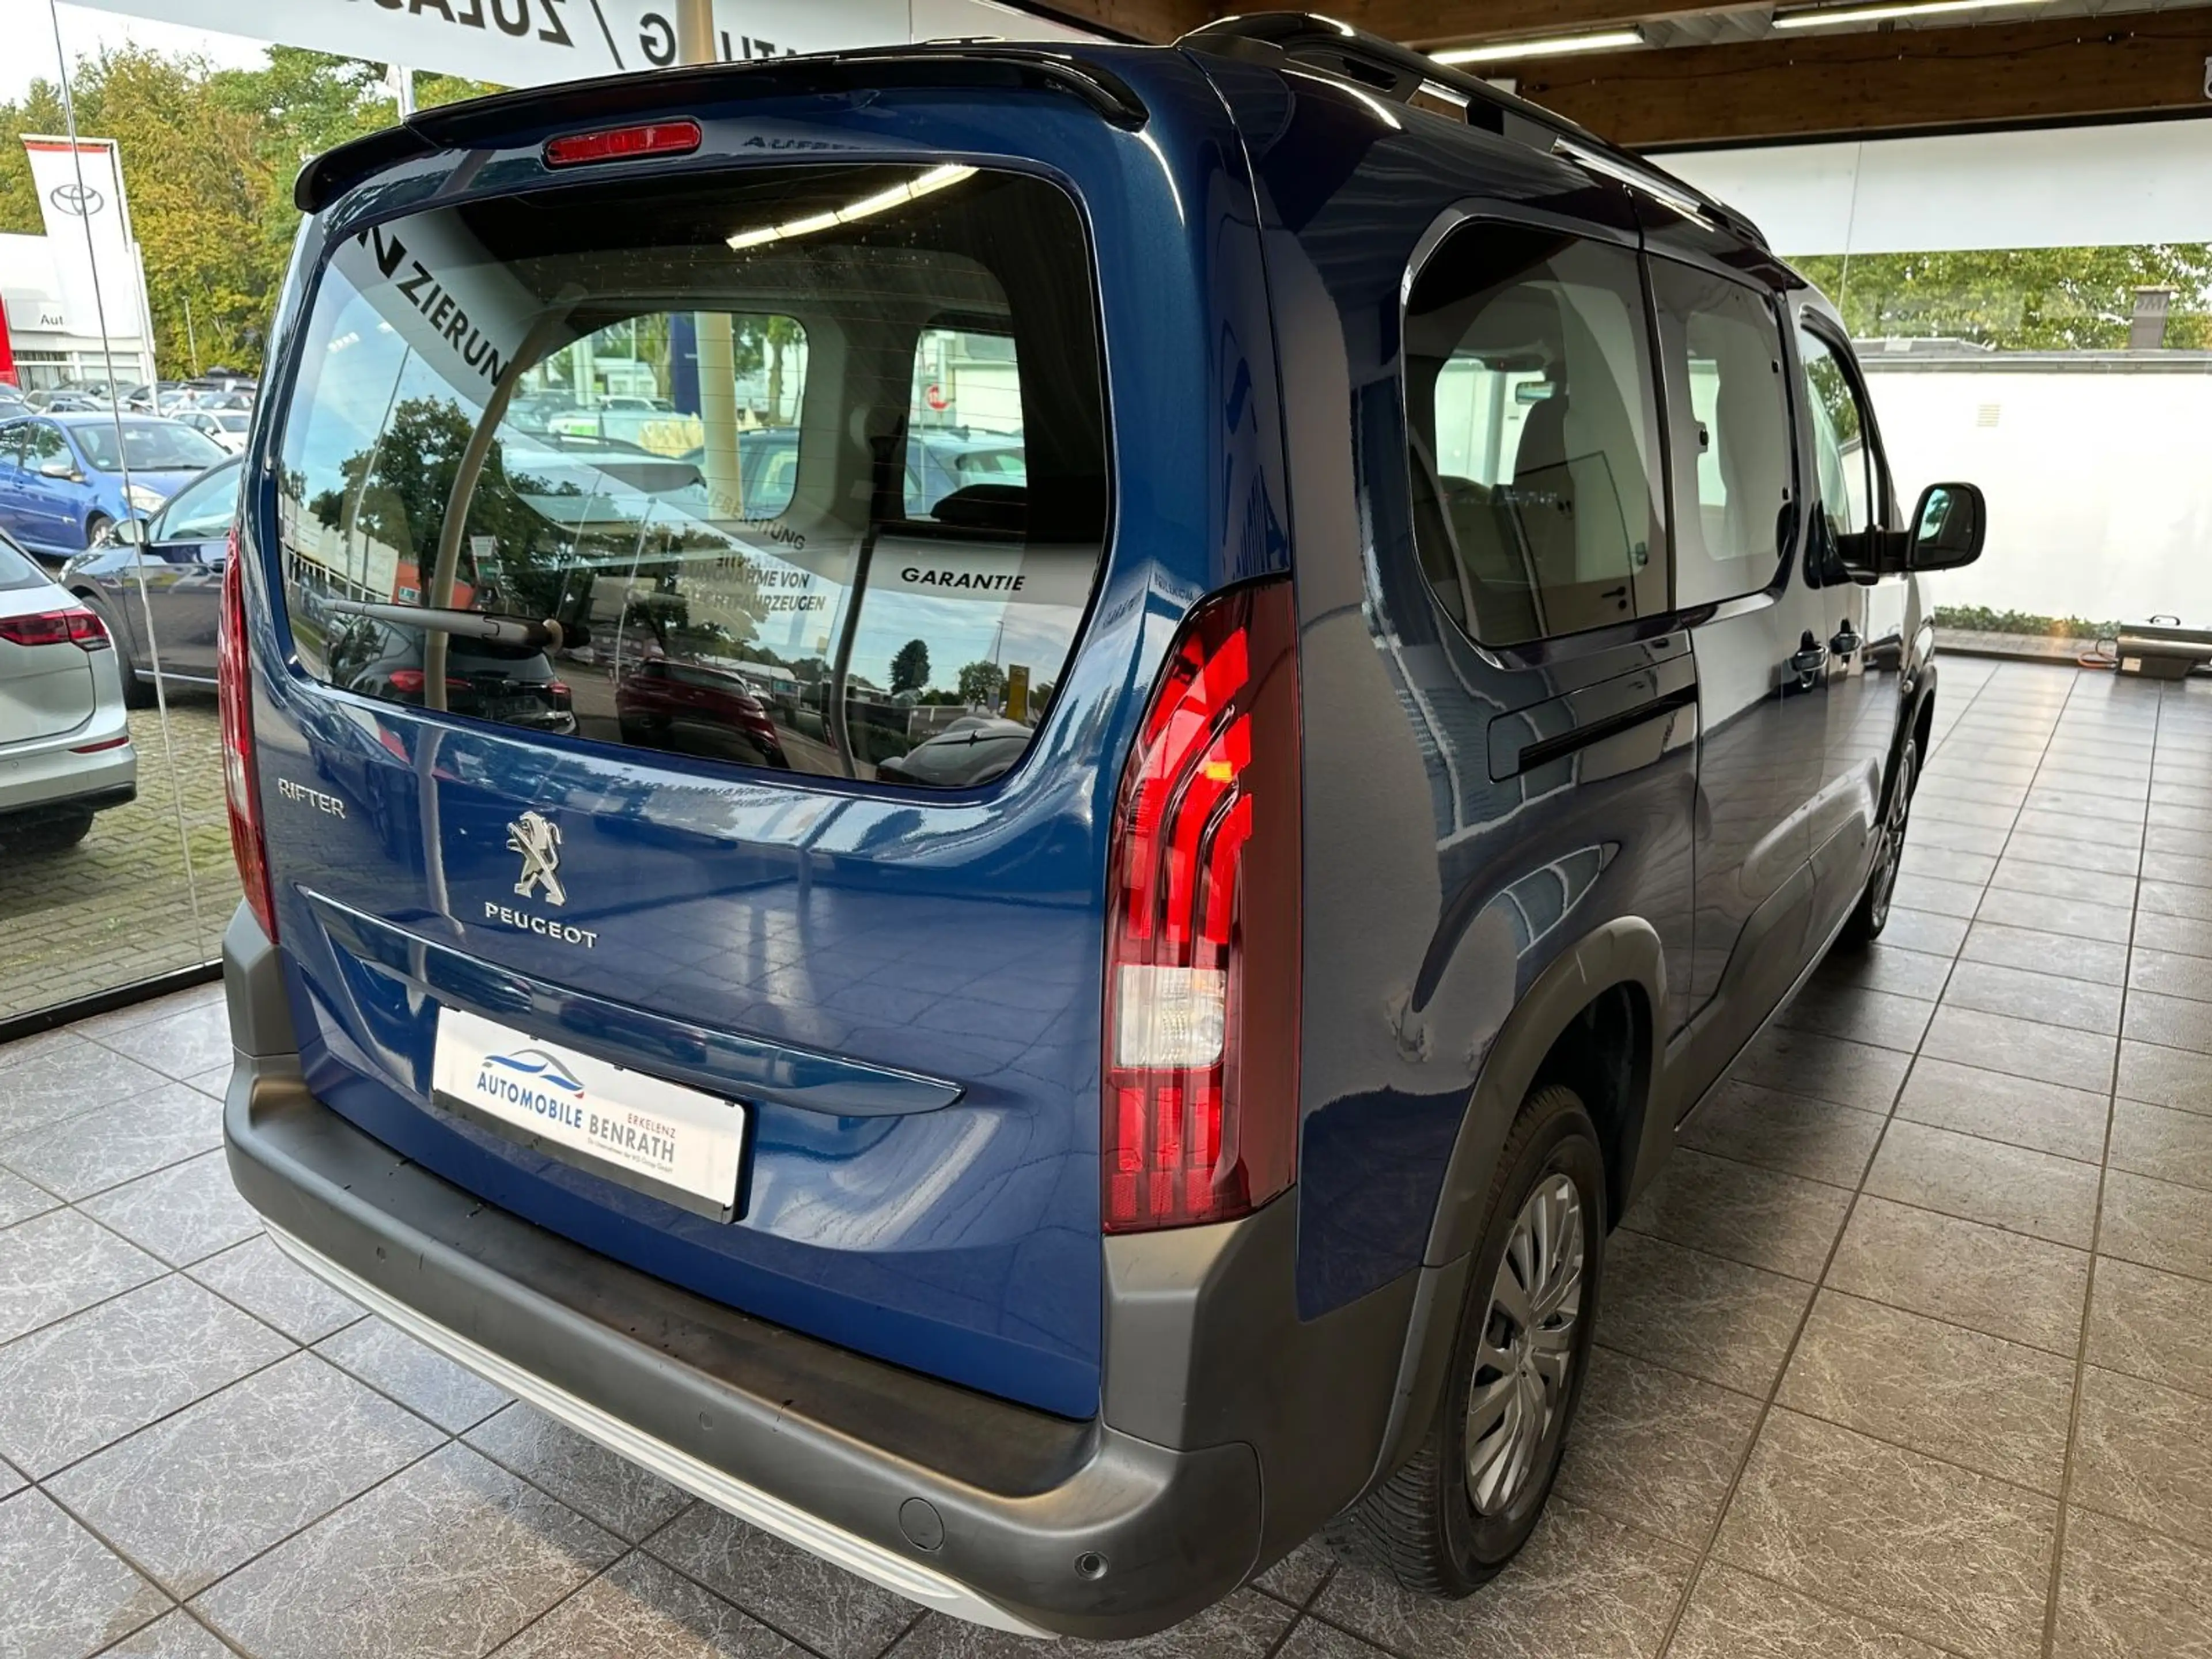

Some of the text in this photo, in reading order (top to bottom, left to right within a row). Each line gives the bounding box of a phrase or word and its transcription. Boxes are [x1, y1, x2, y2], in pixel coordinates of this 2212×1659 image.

[781, 571, 810, 589] VON
[901, 567, 1026, 591] GARANTIE
[278, 778, 346, 819] RIFTER
[484, 901, 599, 949] PEUGEOT
[476, 1071, 583, 1129] AUTOMOBILE
[589, 1113, 675, 1164] BENRATH
[627, 1112, 676, 1139] ERKELENZ
